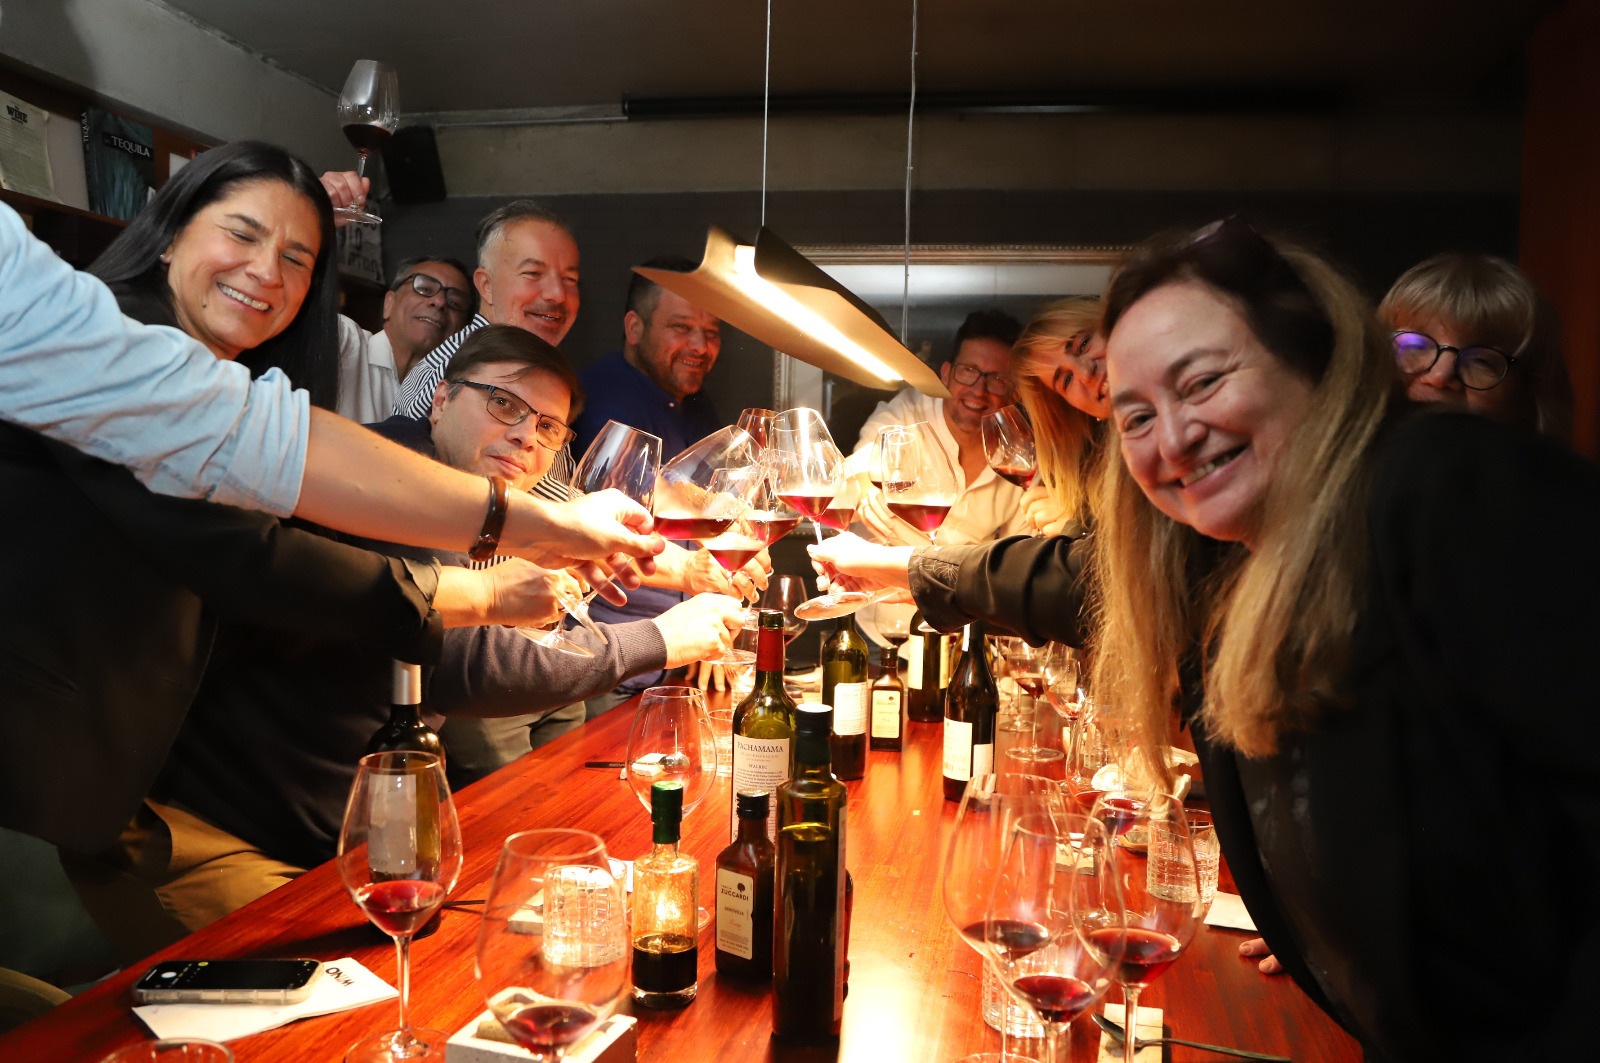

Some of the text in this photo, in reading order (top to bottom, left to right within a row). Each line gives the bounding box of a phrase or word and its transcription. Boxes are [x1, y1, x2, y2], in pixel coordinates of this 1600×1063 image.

[111, 135, 151, 158] TEQUILA
[737, 742, 784, 753] PACHAMAMA
[720, 888, 749, 902] ZUCCARDI
